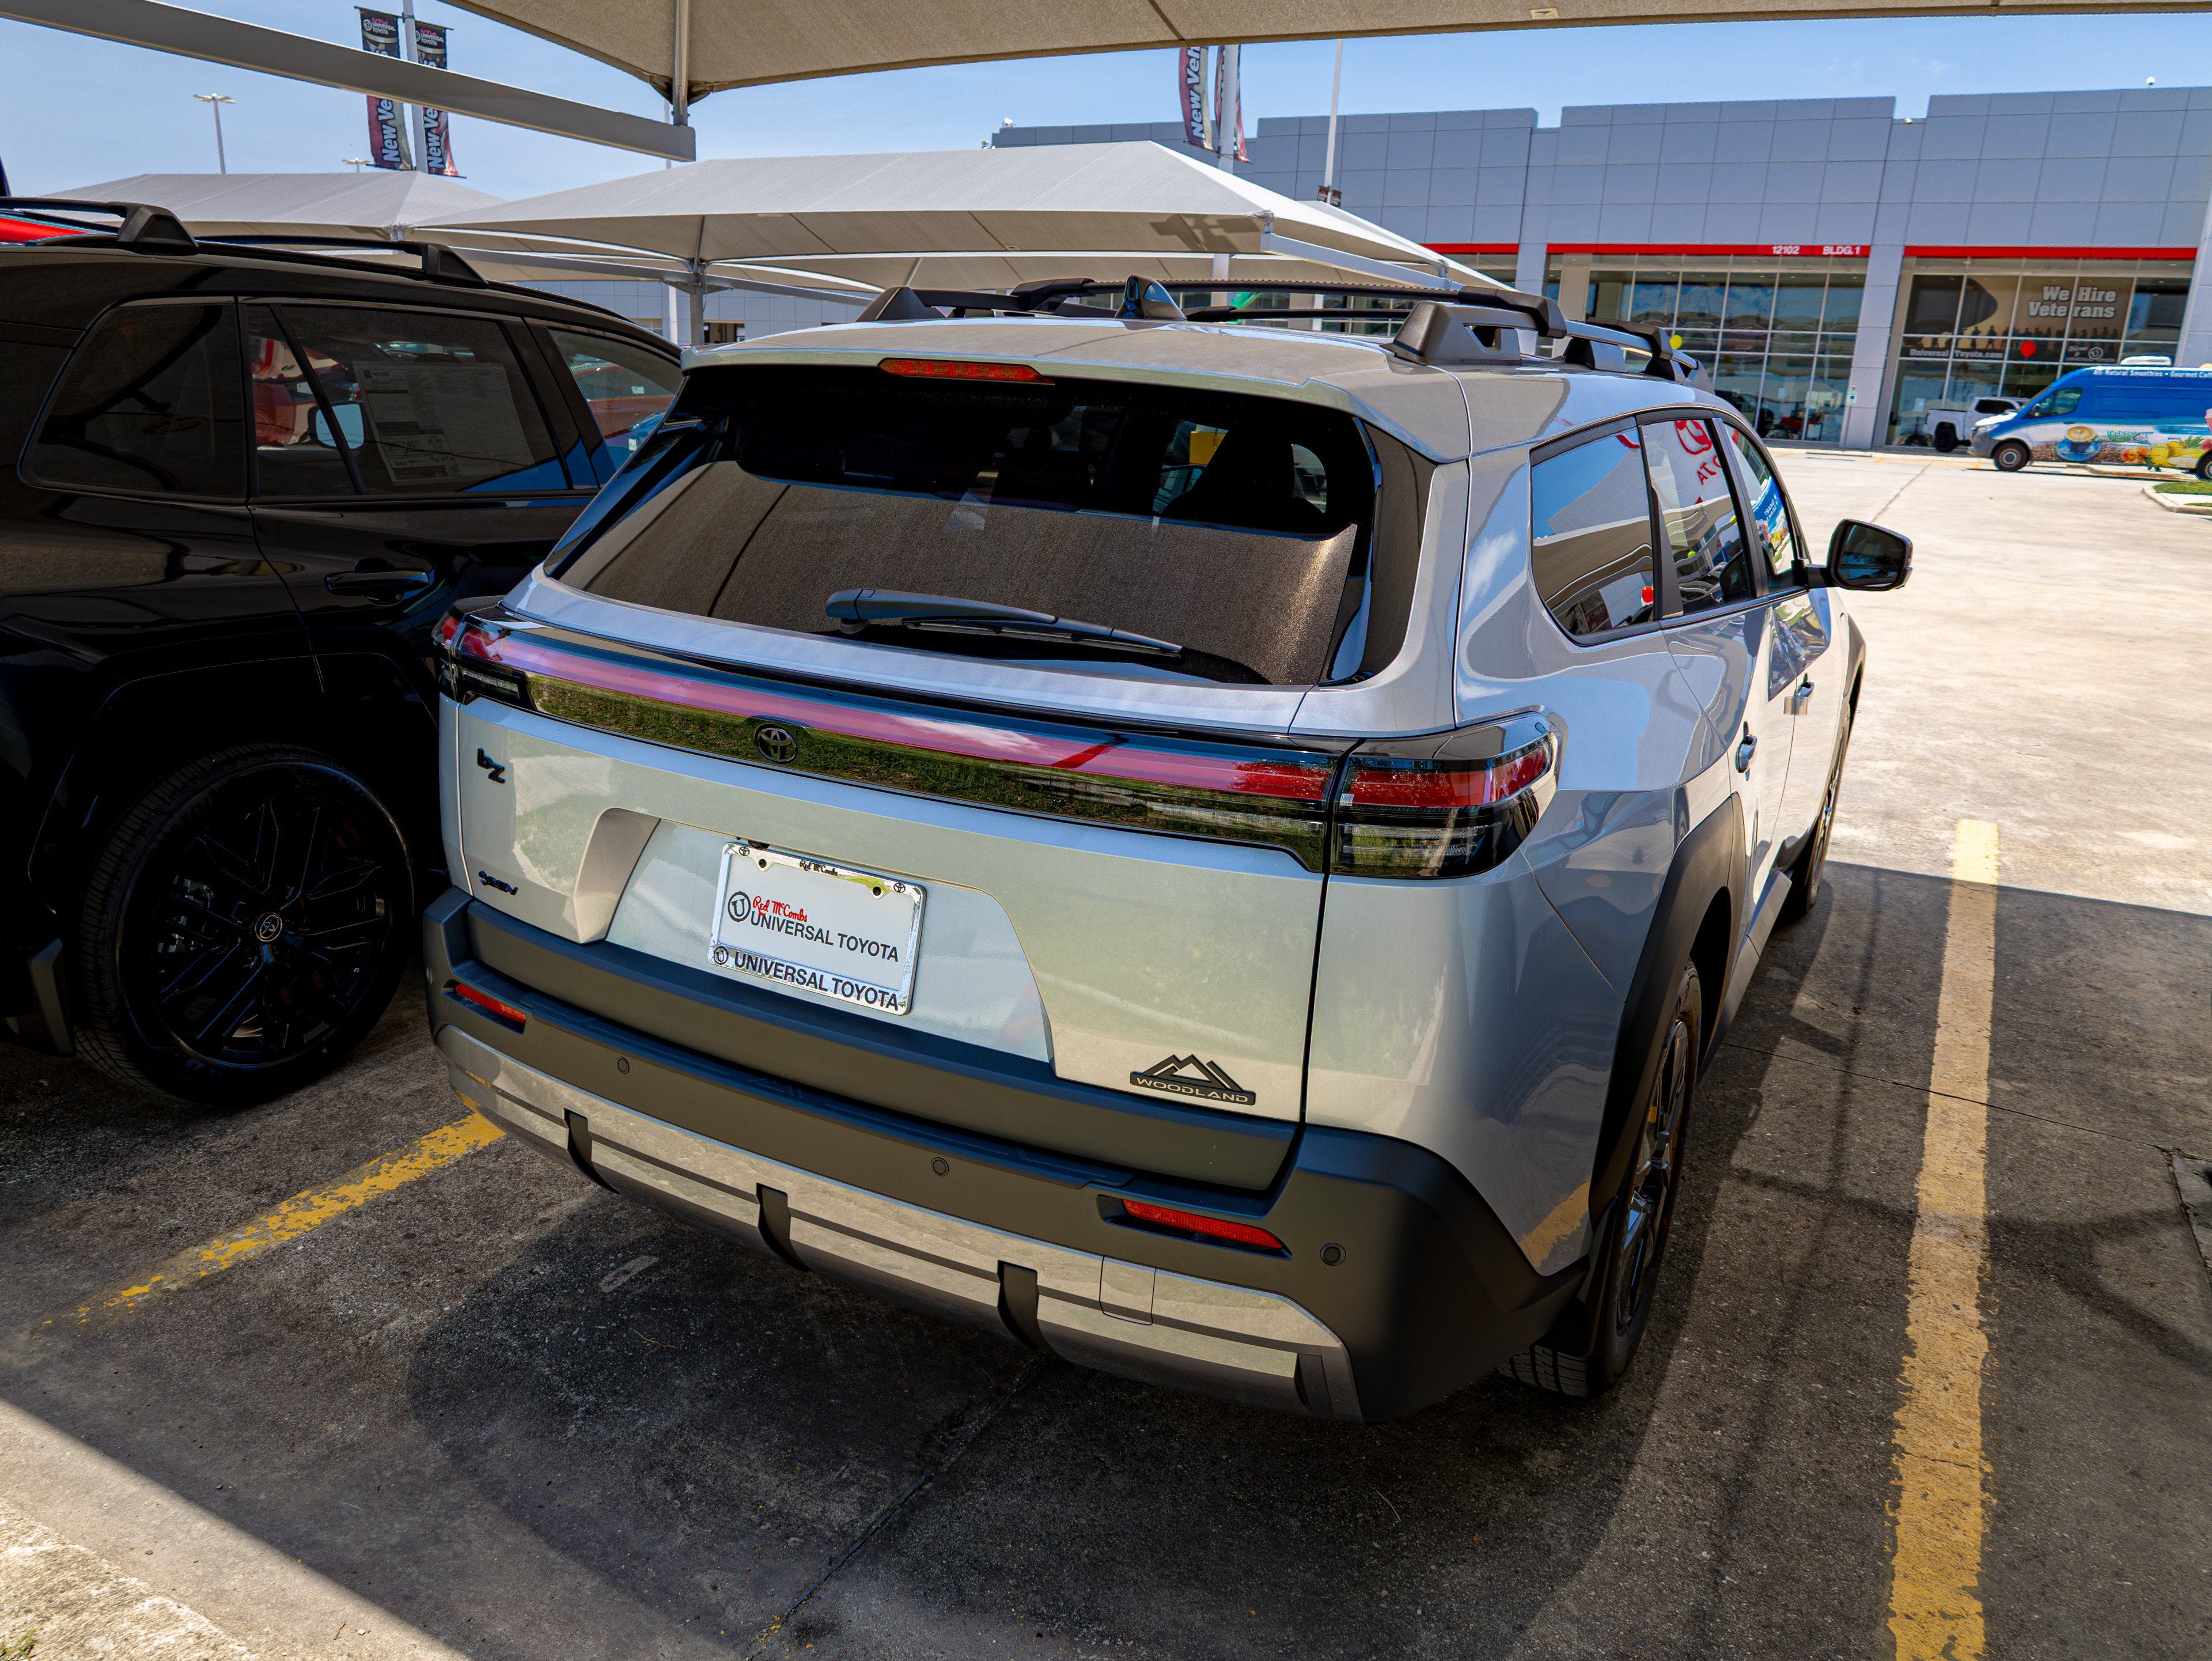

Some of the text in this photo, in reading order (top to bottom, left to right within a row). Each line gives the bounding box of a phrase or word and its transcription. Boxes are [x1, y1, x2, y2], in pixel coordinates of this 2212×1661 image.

[1190, 89, 1205, 138] New
[381, 124, 402, 162] New
[427, 132, 445, 168] New
[1772, 245, 1800, 255] 12102
[2029, 301, 2116, 318] Veterans
[2043, 286, 2117, 302] We Hire
[752, 895, 808, 922] Red McCombs
[751, 911, 899, 963] UNIVERSAL TOYOTA
[734, 951, 828, 992] UNIVERSAL
[832, 978, 899, 1011] TOYOTA
[1137, 1077, 1248, 1103] WOODLAND
